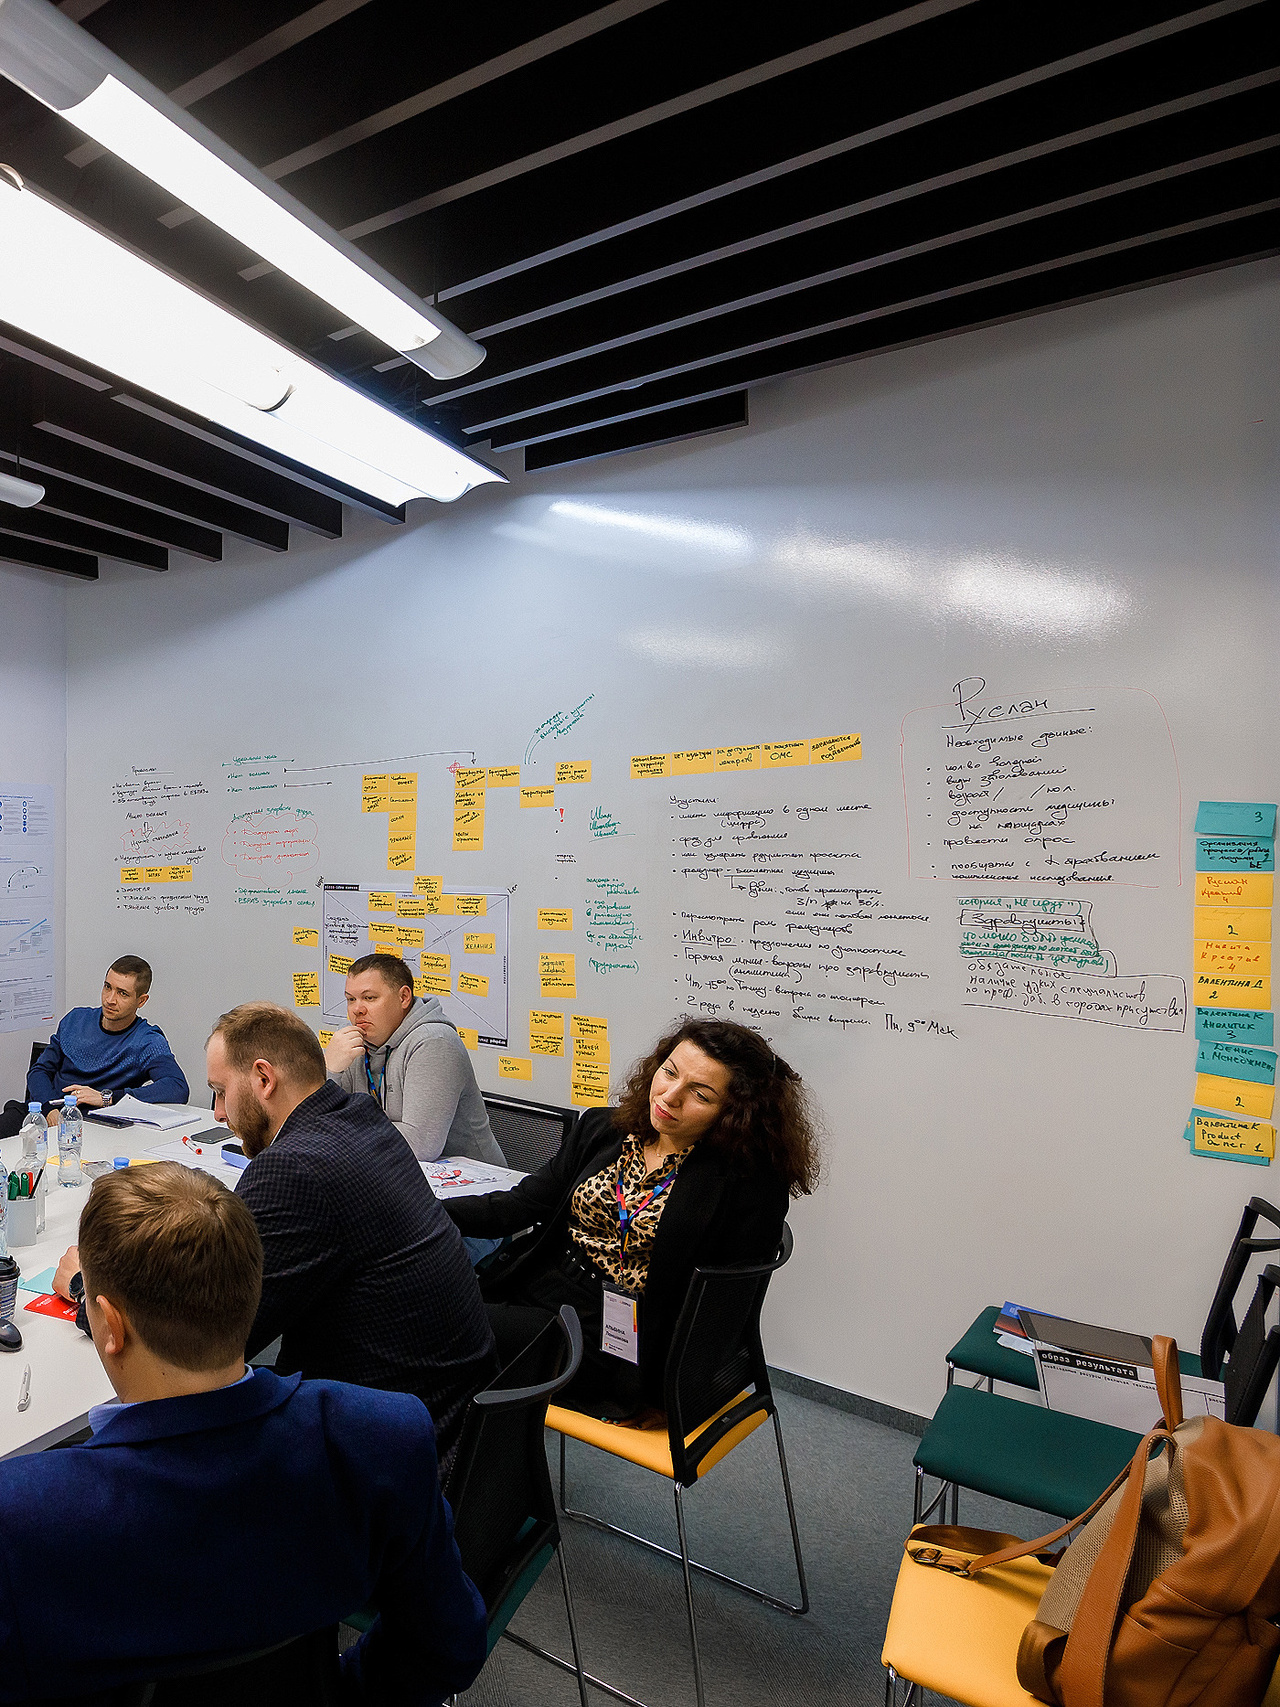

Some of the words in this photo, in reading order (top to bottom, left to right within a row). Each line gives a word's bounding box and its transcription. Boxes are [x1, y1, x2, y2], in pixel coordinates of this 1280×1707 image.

[953, 677, 1048, 733] Руслан
[770, 752, 793, 760] ОМС
[1254, 811, 1263, 823] 3
[1227, 924, 1239, 936] 2
[1197, 975, 1251, 988] ВАЛЕНТИНА
[1209, 991, 1218, 999] 2
[1235, 1096, 1245, 1108] 2
[1202, 1128, 1241, 1140] Product
[1042, 1352, 1070, 1364] образ
[1076, 1359, 1135, 1377] результата
